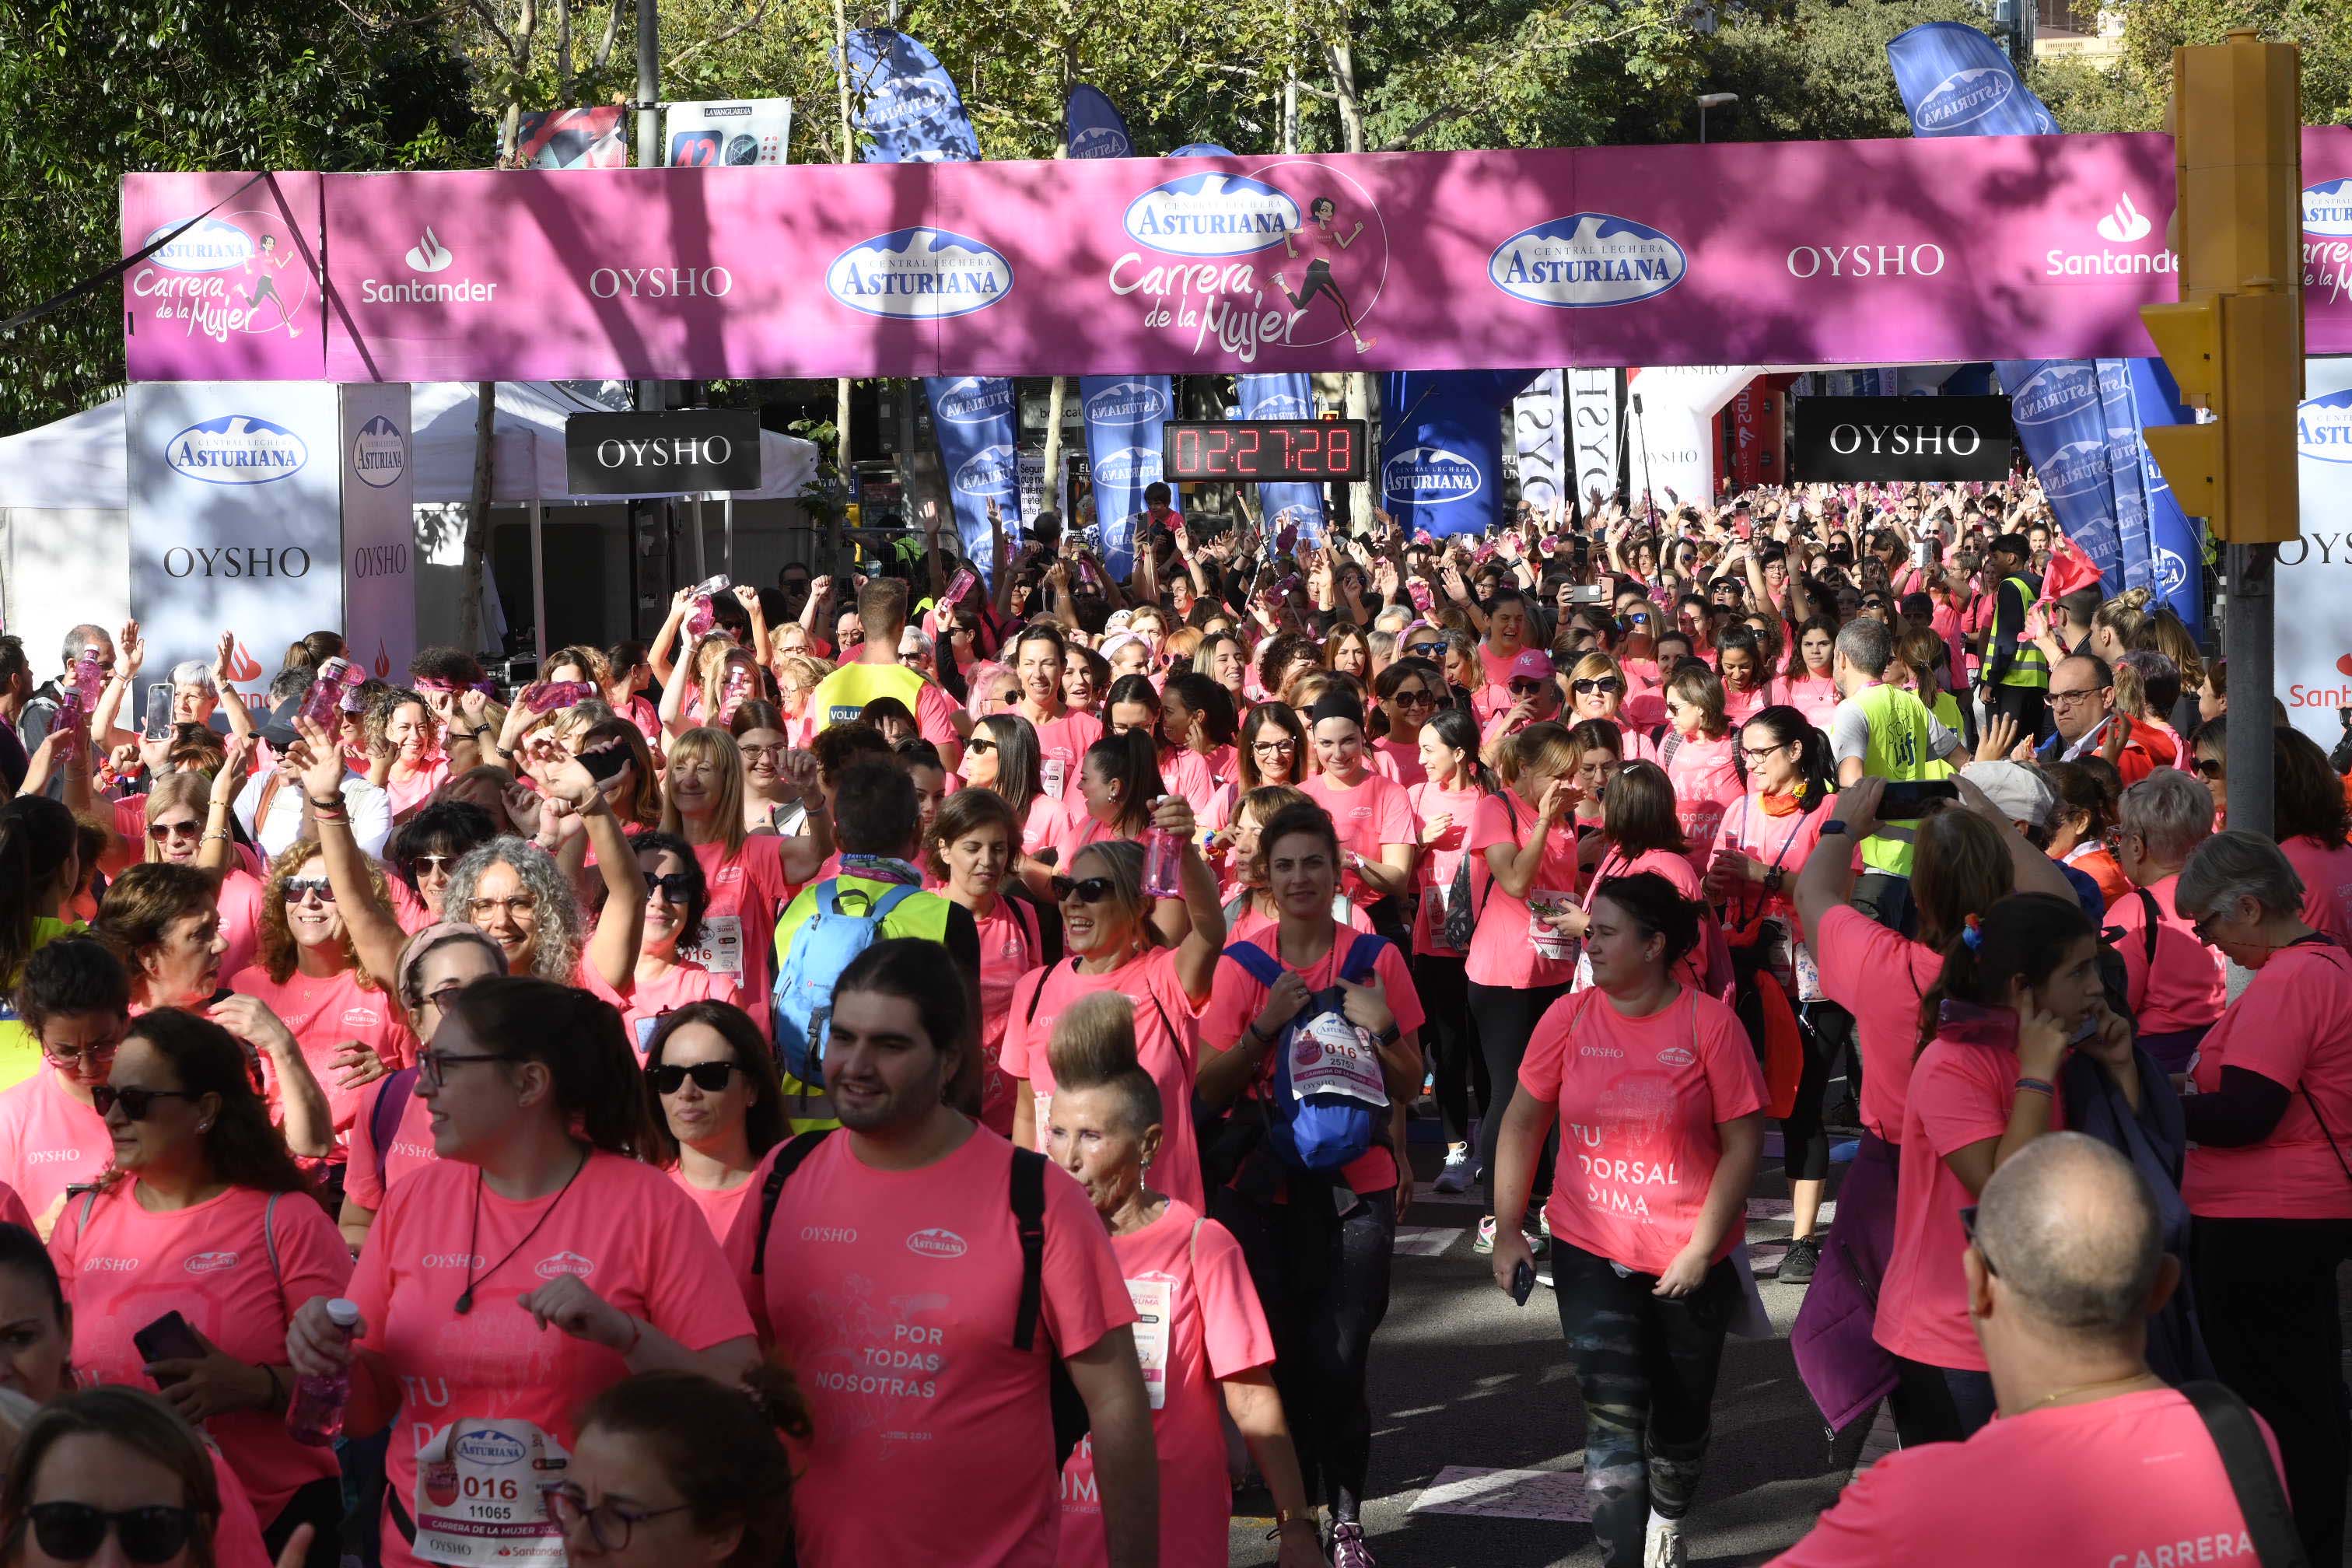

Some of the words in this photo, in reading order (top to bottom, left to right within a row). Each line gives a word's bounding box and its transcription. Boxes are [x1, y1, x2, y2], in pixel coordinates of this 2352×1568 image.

[1138, 205, 1286, 236] ASTURIANA
[152, 236, 244, 257] ASTURIANA
[1535, 246, 1595, 256] CENTRAL
[1601, 244, 1664, 254] LECHERA
[870, 258, 929, 268] CENTRAL
[934, 257, 992, 268] LECHERA
[1503, 249, 1671, 283] ASTURIANA
[1787, 243, 1945, 278] OYSHO
[133, 268, 225, 297] Carrera
[590, 266, 733, 299] OYSHO
[842, 261, 999, 296] ASTURIANA
[1109, 252, 1255, 296] Carrera
[362, 278, 498, 304] Santander
[156, 299, 173, 319] de
[177, 299, 189, 319] la
[187, 295, 260, 343] Mujer
[1144, 297, 1172, 328] de
[1177, 296, 1197, 327] la
[1193, 290, 1309, 363] Mujer
[177, 441, 298, 467] ASTURIANA
[597, 435, 732, 468] OYSHO
[1176, 429, 1350, 472] 02:27:28
[1829, 424, 1981, 459] OYSHO
[357, 443, 402, 471] ASTURIANA
[1020, 476, 1034, 485] que
[1386, 470, 1475, 491] ASTURIANA
[163, 546, 310, 578] OYSHO
[355, 544, 407, 579] OYSHO
[1425, 868, 1444, 882] TU
[1325, 1043, 1357, 1059] 016
[1580, 1045, 1624, 1059] OYSHO
[1571, 1122, 1601, 1147] TU
[29, 1149, 81, 1164] OYSHO
[801, 1226, 858, 1244] OYSHO
[911, 1237, 962, 1253] ASTURIANA
[84, 1258, 139, 1273] OYSHO
[422, 1253, 486, 1270] OYSHO
[894, 1324, 943, 1346] POR
[863, 1347, 940, 1372] TODAS
[401, 1375, 450, 1407] TU
[816, 1371, 936, 1398] NOSOTRAS
[459, 1440, 520, 1458] ASTURIANA
[464, 1475, 518, 1500] 016
[469, 1505, 511, 1520] 11065
[432, 1520, 471, 1533] CARRERA
[472, 1525, 485, 1535] DE
[487, 1526, 499, 1535] LA
[501, 1526, 535, 1535] MUJER
[429, 1538, 472, 1556] OYSHO
[512, 1547, 564, 1556] Santander
[2109, 1529, 2256, 1568] CARRERA
